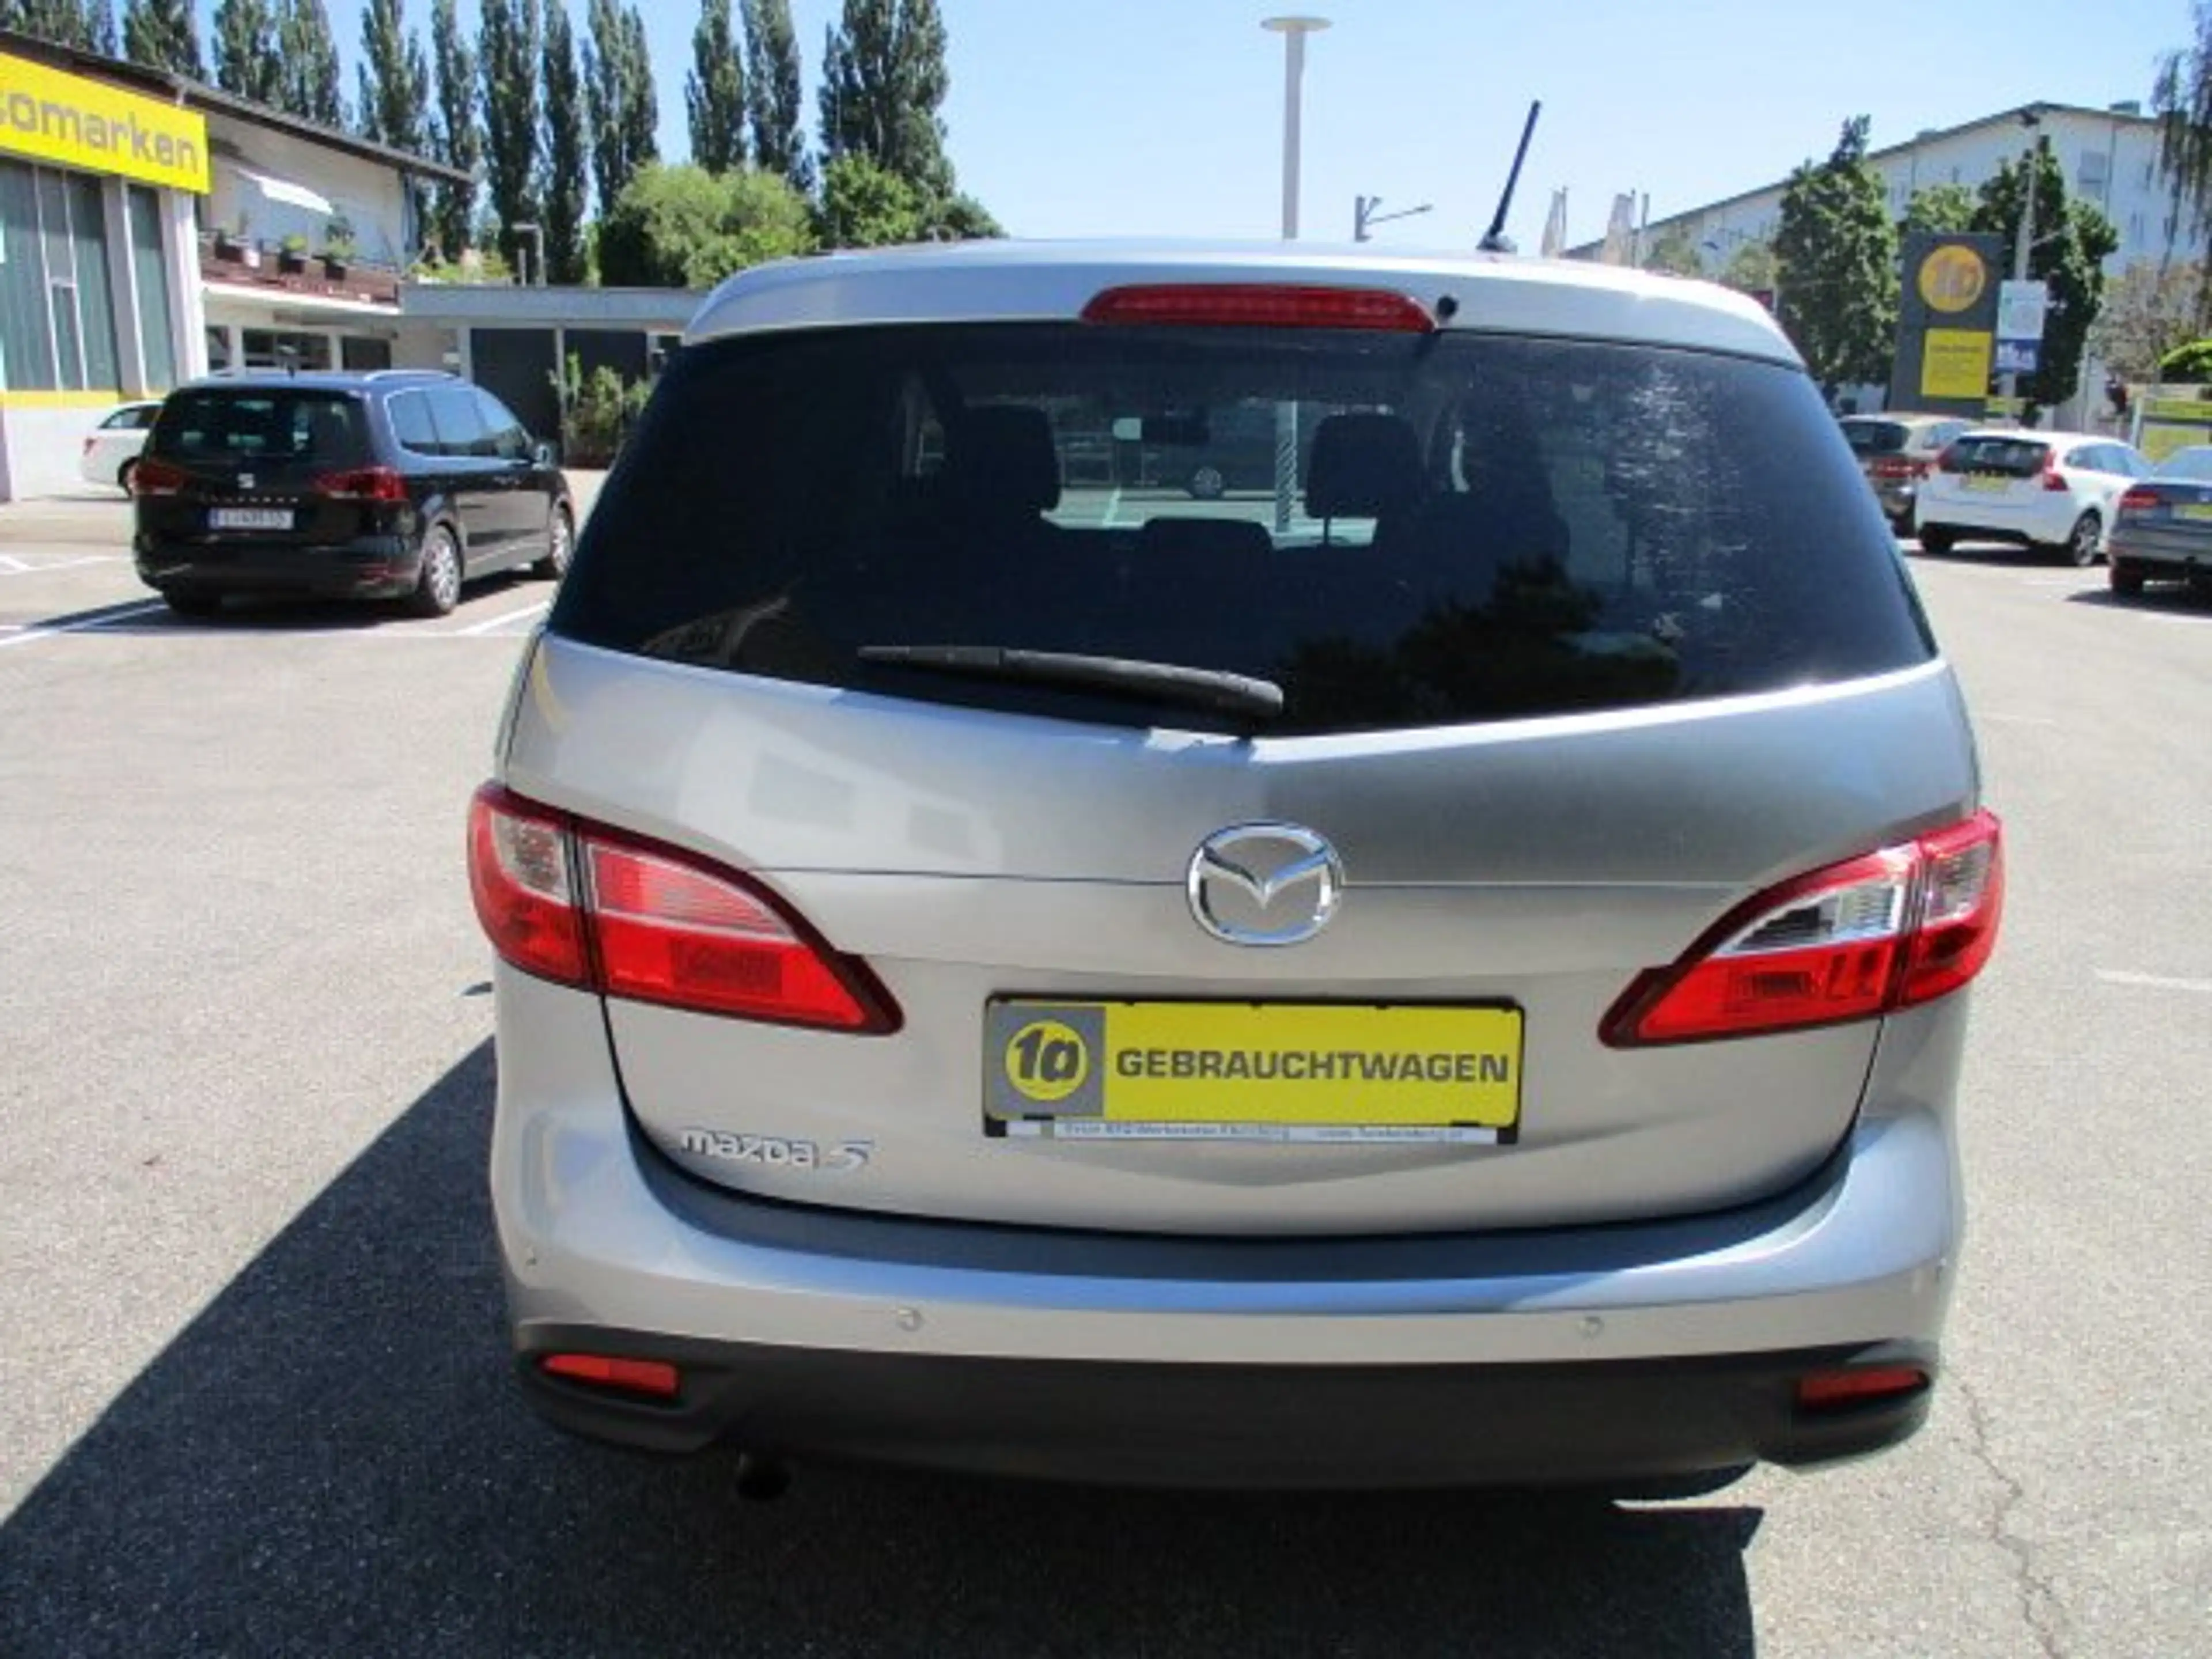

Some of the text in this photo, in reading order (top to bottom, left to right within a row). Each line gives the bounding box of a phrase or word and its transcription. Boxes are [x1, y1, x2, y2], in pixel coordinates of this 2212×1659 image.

[0, 94, 199, 175] omarken
[1014, 1028, 1509, 1083] 1a GEBRAUCHTWAGEN
